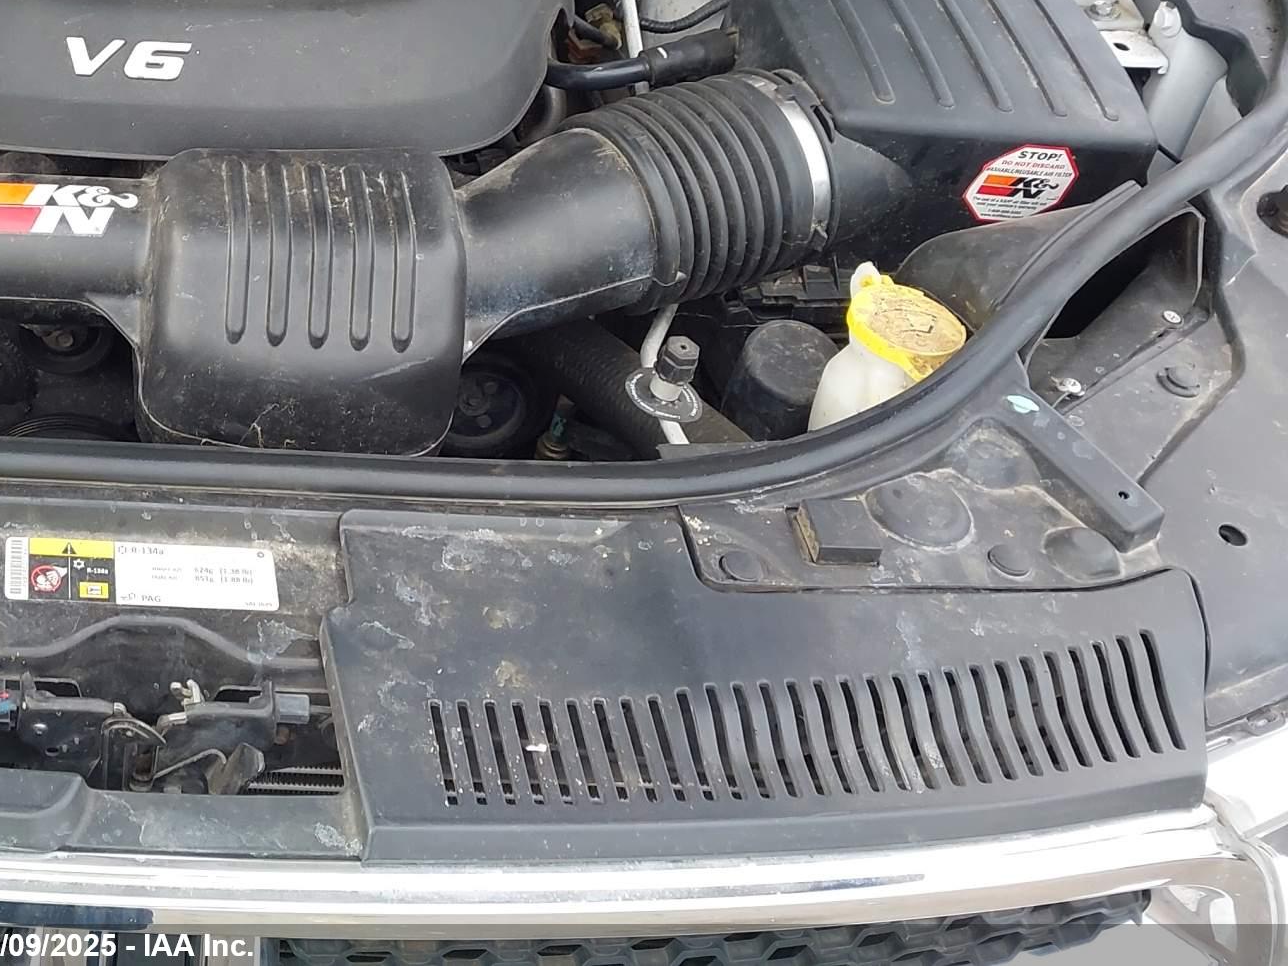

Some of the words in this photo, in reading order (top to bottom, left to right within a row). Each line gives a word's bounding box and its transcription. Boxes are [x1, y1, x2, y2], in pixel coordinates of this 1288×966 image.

[65, 36, 193, 81] V6
[1018, 150, 1064, 162] STOP!
[1032, 162, 1066, 170] DISCARD
[22, 184, 139, 235] K&N
[141, 594, 162, 603] PAG
